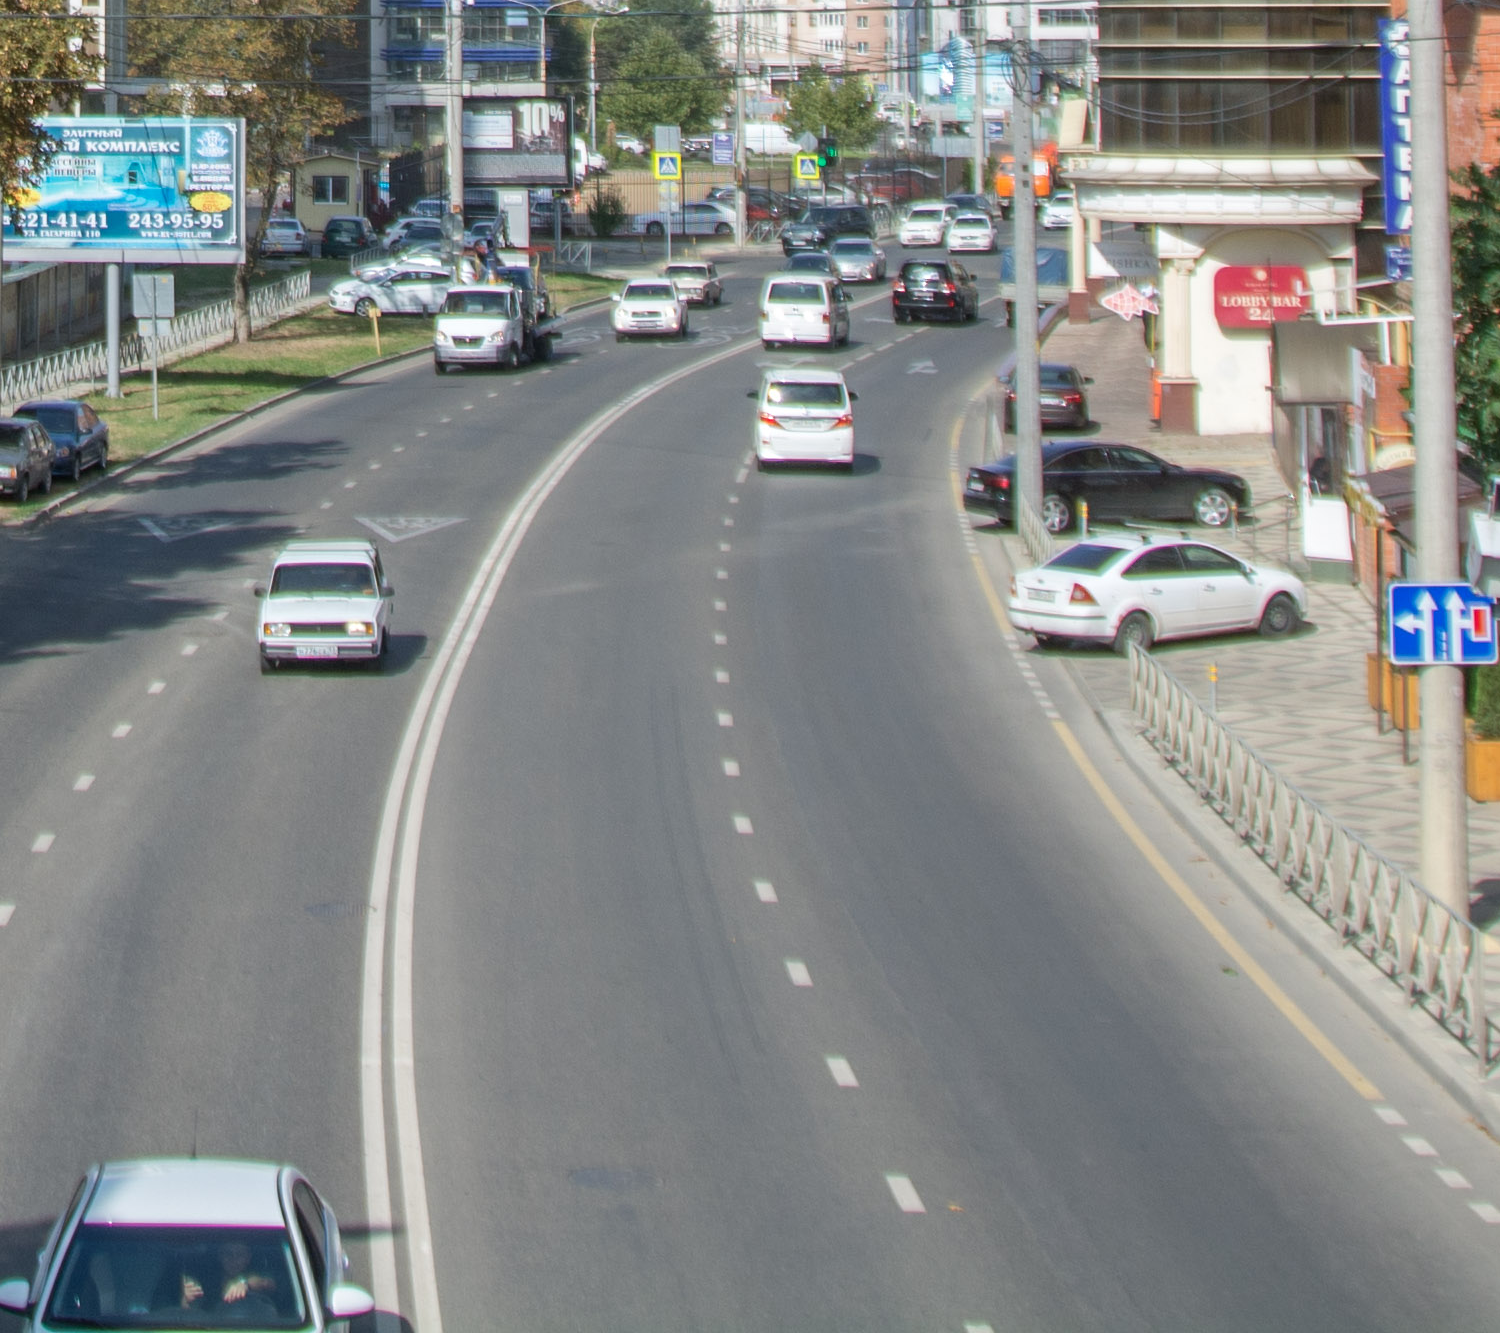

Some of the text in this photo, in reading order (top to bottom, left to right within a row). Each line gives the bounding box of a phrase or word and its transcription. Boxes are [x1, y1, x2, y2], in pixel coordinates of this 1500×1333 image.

[518, 101, 566, 137] 10%
[85, 141, 181, 153] КОМПЛЕКС
[48, 156, 96, 166] АССЕЙНЫ
[128, 213, 224, 229] 243-95-95
[1221, 296, 1302, 308] LOBBY BAR
